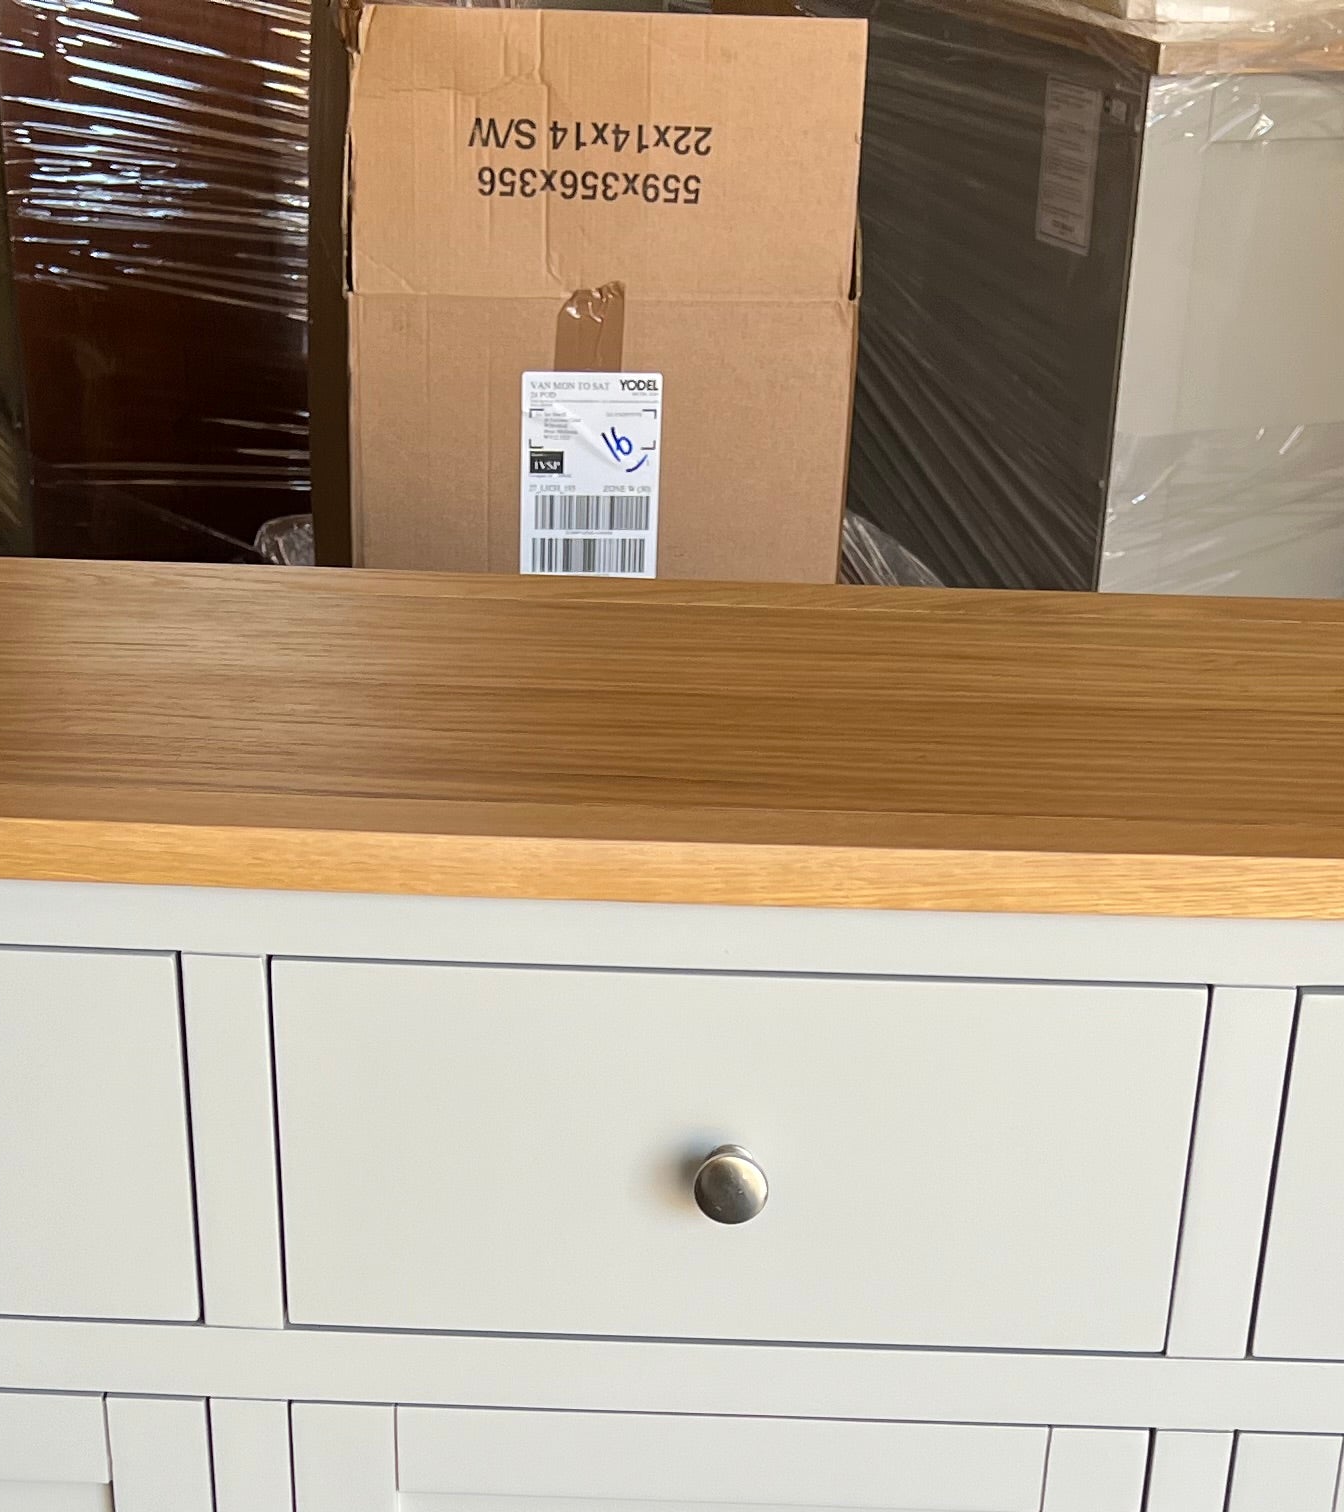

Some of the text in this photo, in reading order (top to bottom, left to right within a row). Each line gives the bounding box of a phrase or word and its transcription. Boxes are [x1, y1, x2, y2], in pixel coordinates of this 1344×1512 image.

[468, 117, 713, 157] 22x14x14 S/W
[477, 165, 702, 205] 559x356x356
[530, 381, 610, 391] VAN MON TO SAT
[620, 379, 659, 391] YODEL
